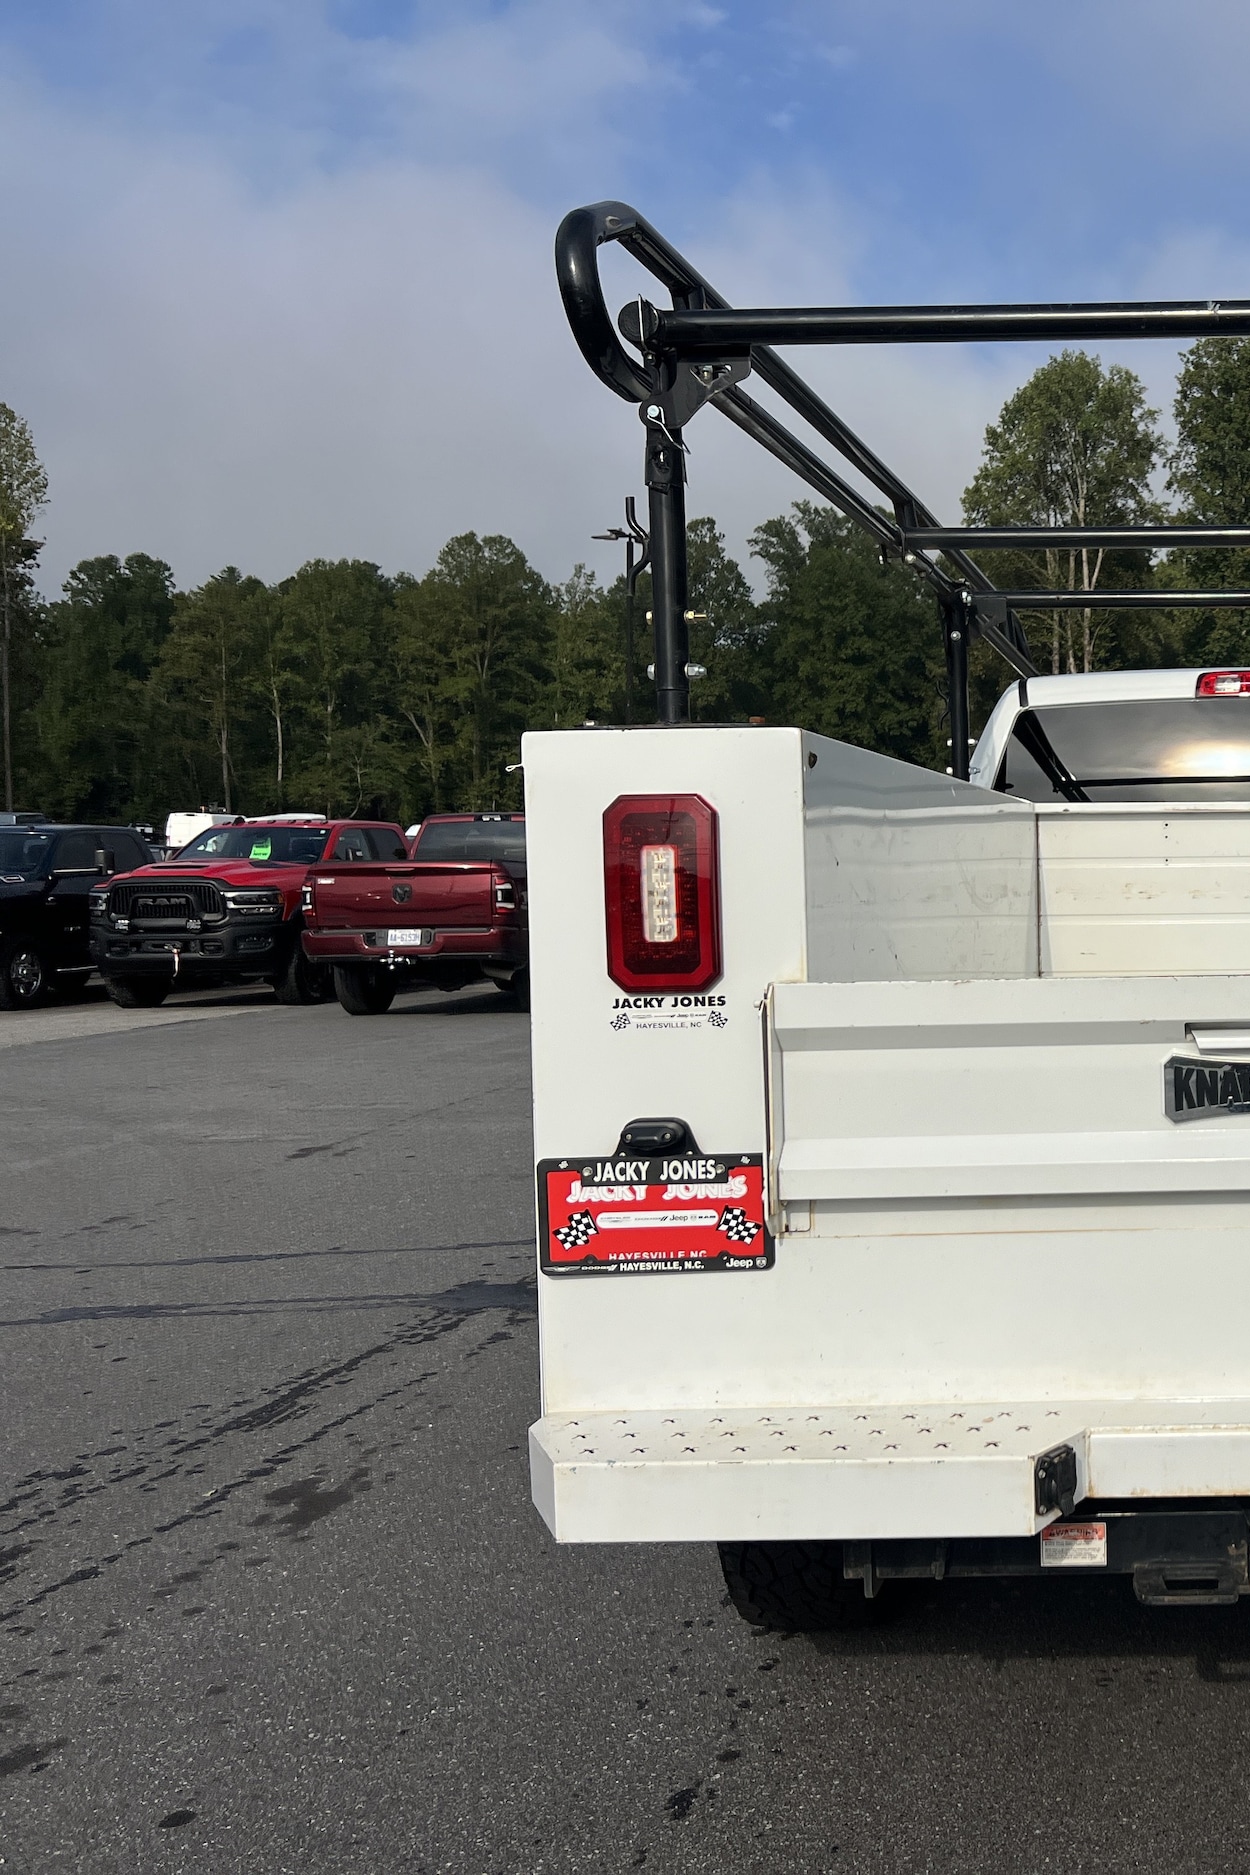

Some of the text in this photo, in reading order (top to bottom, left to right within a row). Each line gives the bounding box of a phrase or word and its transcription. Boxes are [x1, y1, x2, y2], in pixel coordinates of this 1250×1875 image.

[138, 898, 186, 906] RAM
[612, 995, 726, 1009] JACKY JONES
[636, 1022, 688, 1030] HAYESVILLE,
[593, 1159, 716, 1182] JACKY JONES
[566, 1175, 748, 1203] JACKY JONES
[669, 1214, 689, 1222] Jeep
[620, 1260, 705, 1271] HAYESVILLE, N.C.
[726, 1257, 753, 1269] Jeep
